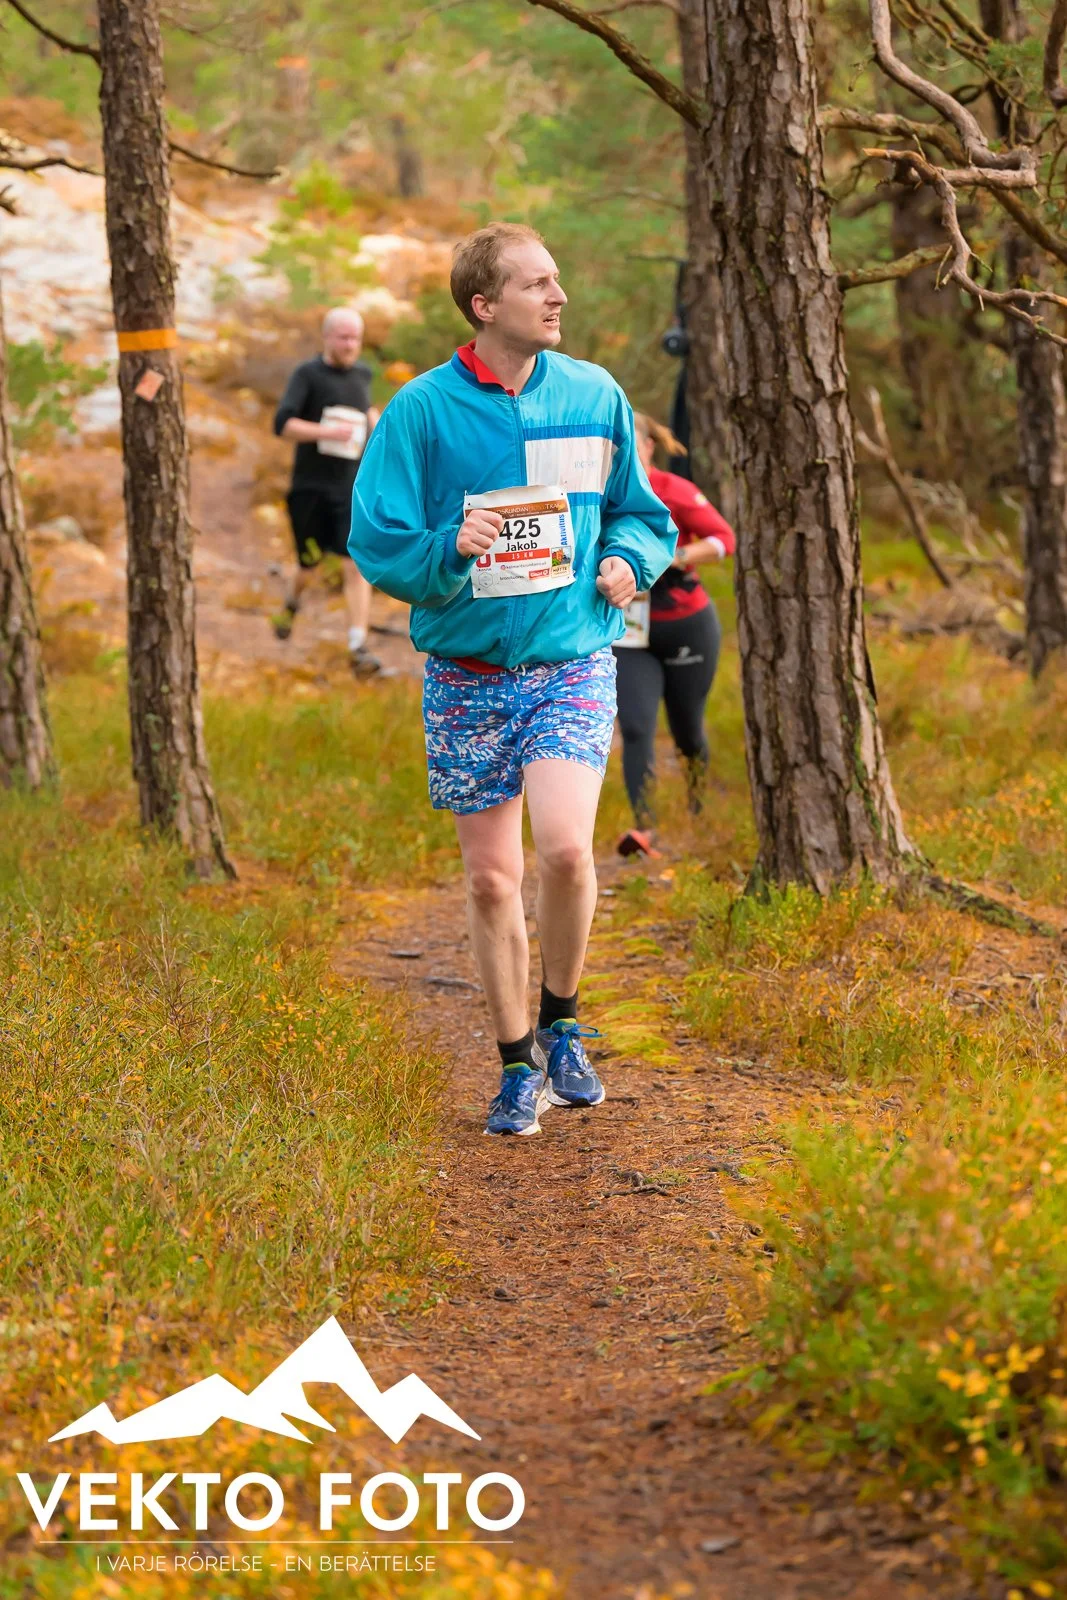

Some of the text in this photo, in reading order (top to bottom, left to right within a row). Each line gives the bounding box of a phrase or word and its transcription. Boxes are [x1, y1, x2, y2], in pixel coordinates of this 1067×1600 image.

[499, 517, 541, 540] 425
[558, 514, 568, 546] Aktivitus
[505, 540, 538, 552] Jakob
[511, 552, 520, 560] 15
